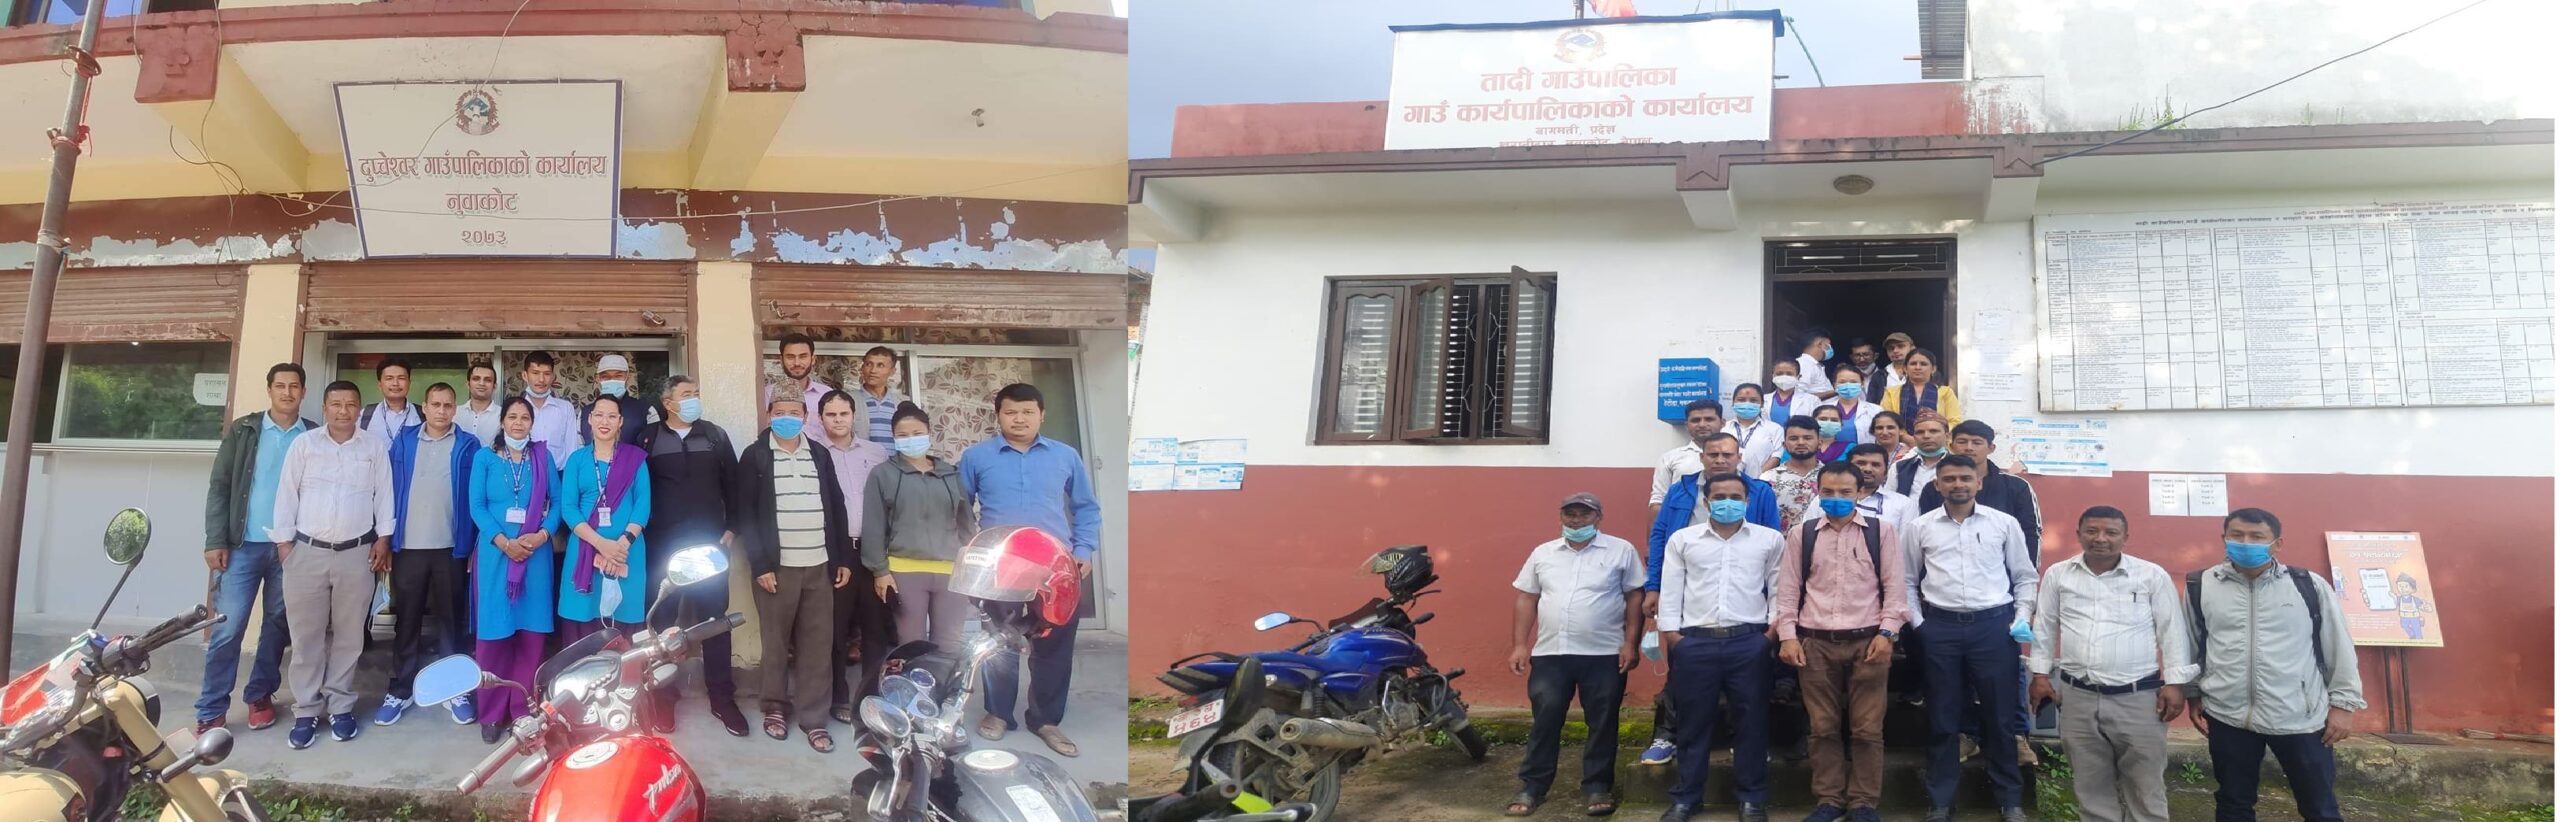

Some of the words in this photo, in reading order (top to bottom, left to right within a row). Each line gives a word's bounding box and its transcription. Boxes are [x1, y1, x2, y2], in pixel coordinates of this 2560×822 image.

[1480, 67, 1534, 92] तादी
[1456, 94, 1635, 122] कार्यपालिकाको
[1642, 92, 1754, 117] कार्यालय
[423, 150, 530, 175] गाउँपालिकाको
[535, 150, 606, 175] कार्यालय
[445, 188, 518, 216] नुवाकोट
[461, 229, 507, 245] २०७३
